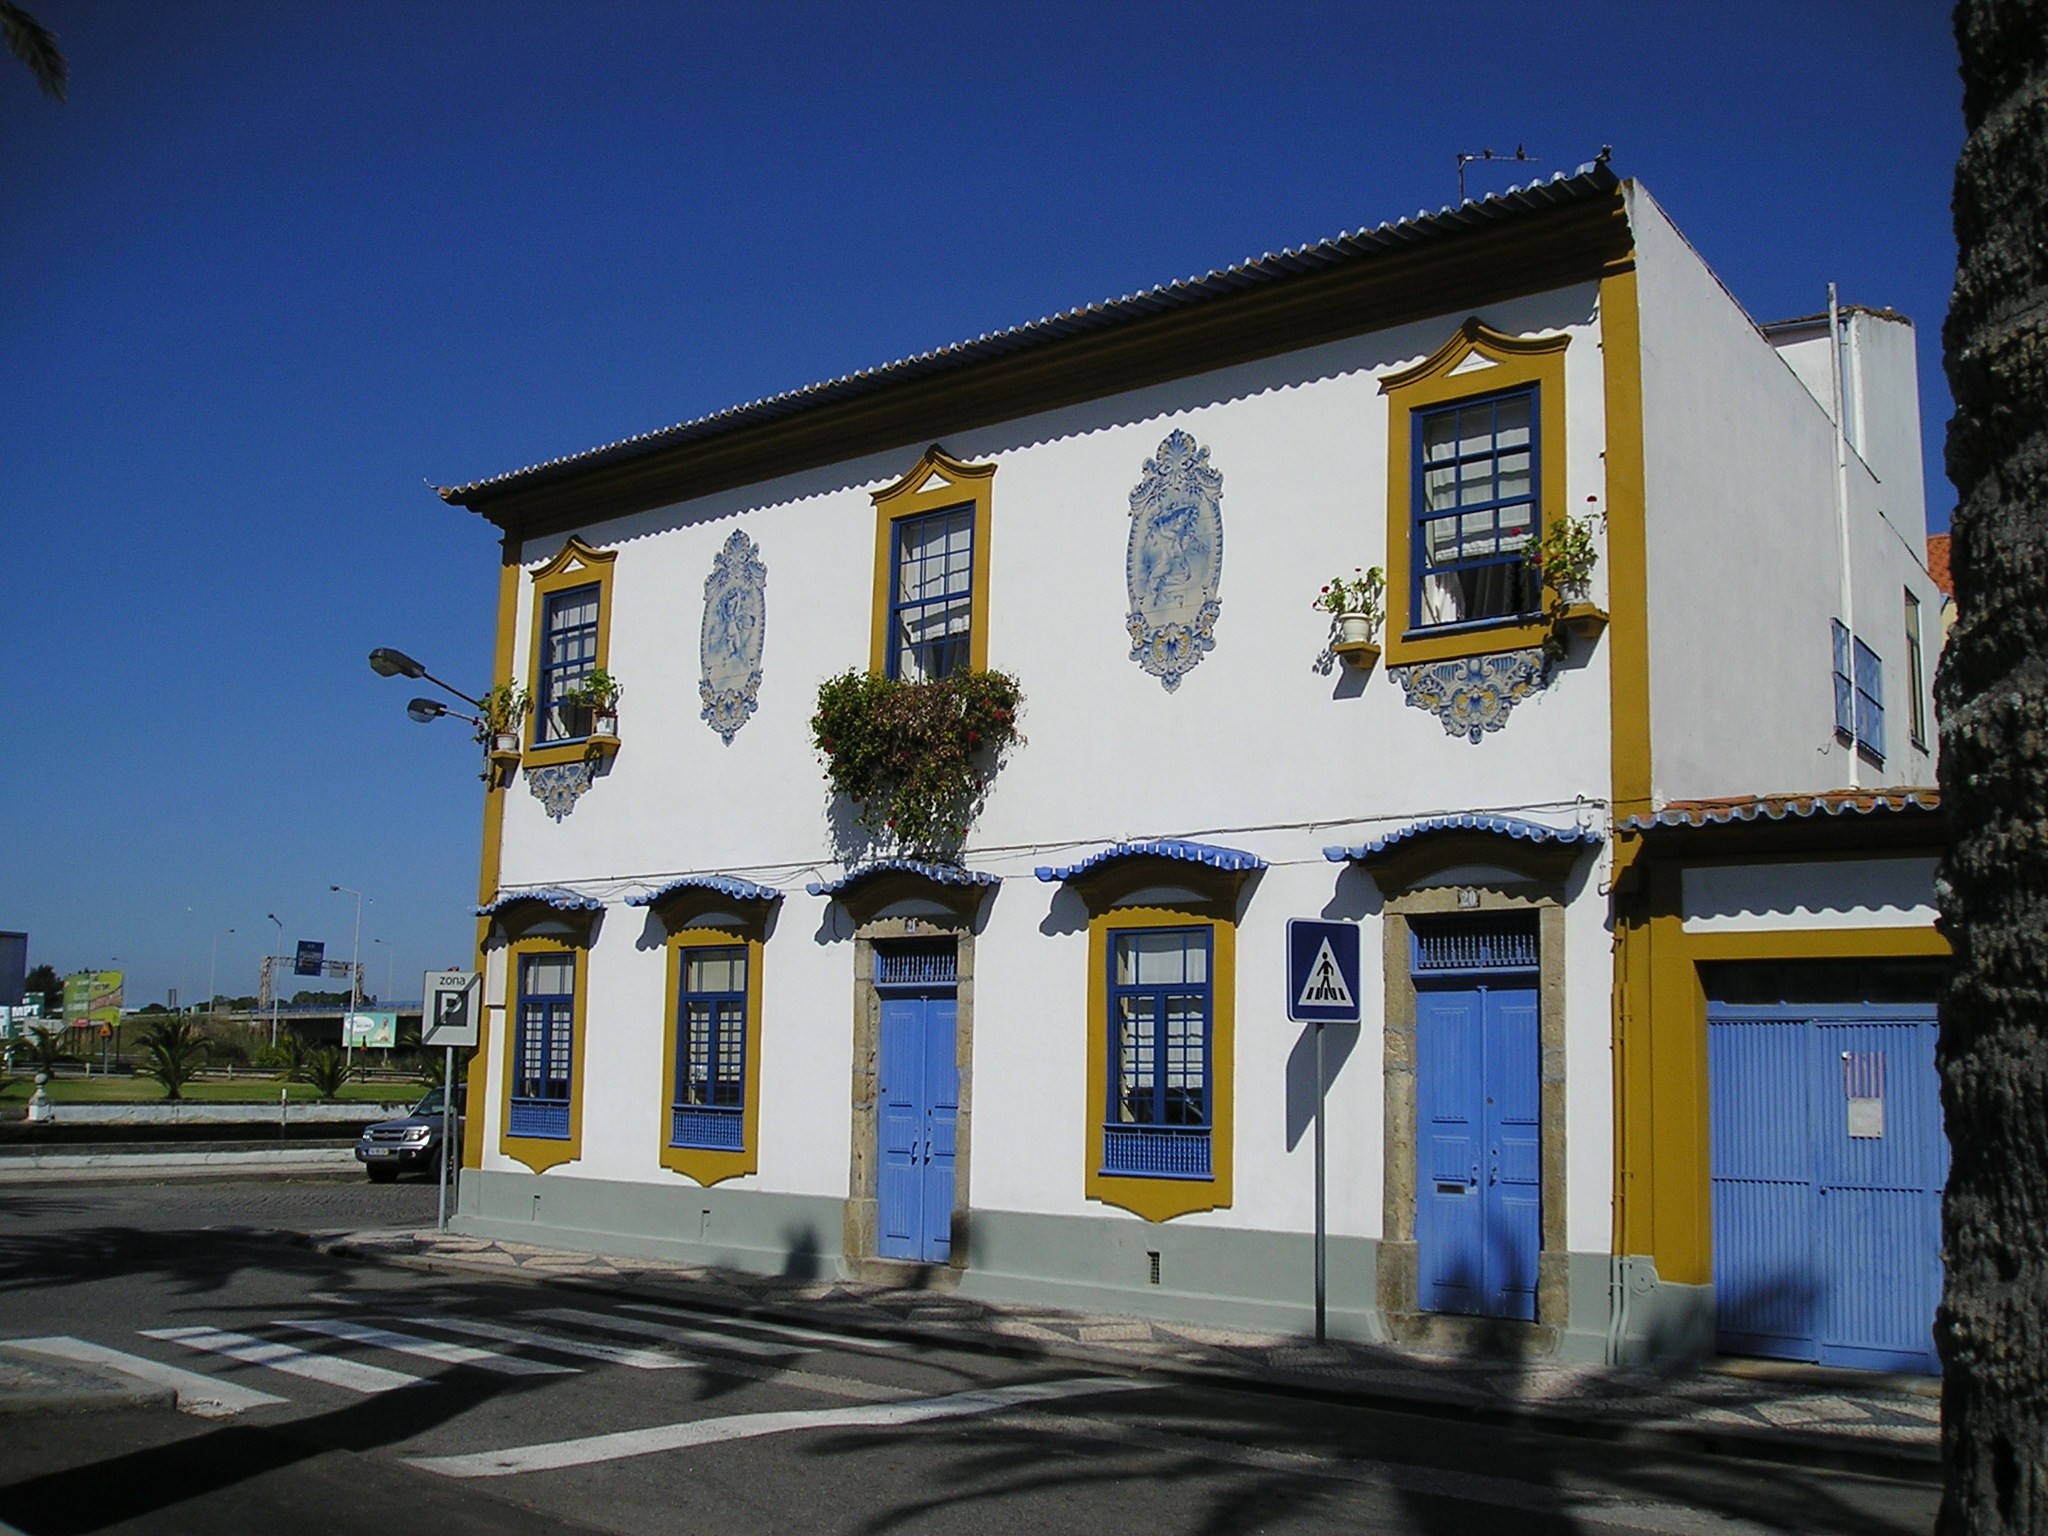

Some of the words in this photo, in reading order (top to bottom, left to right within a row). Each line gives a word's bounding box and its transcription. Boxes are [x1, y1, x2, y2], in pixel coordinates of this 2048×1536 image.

[1460, 890, 1476, 906] 20
[440, 976, 466, 986] zona
[12, 1004, 40, 1017] MPT
[441, 992, 462, 1023] P
